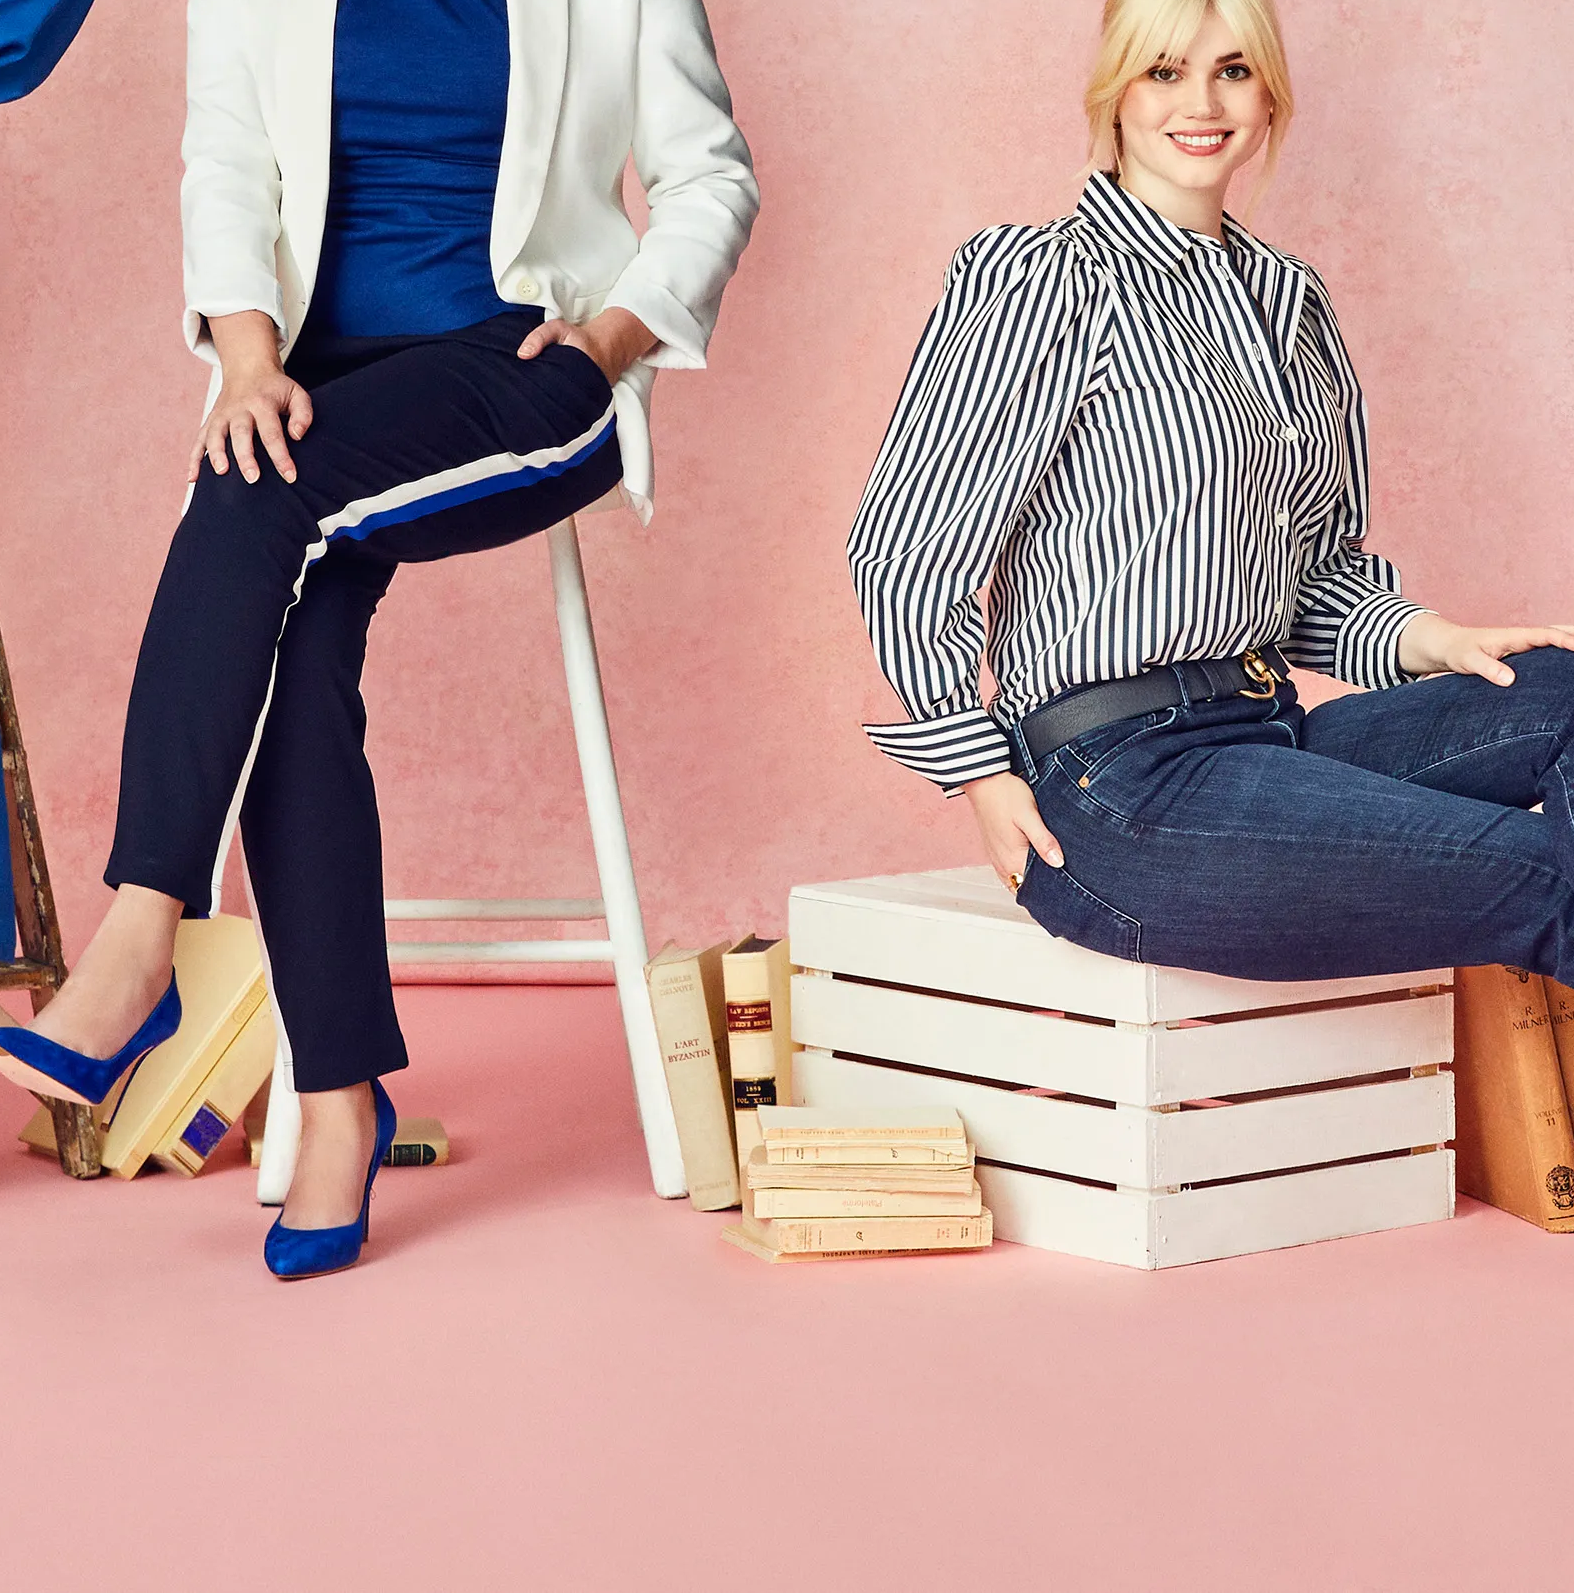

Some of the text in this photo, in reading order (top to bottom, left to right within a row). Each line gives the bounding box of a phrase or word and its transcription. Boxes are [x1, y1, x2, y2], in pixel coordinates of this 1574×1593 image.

[1525, 1006, 1536, 1016] R.
[1559, 1001, 1570, 1010] R.
[1512, 1014, 1550, 1031] MILNER
[674, 1038, 700, 1050] L'ART
[668, 1049, 711, 1063] BYZANTIN
[1546, 1117, 1557, 1127] 11
